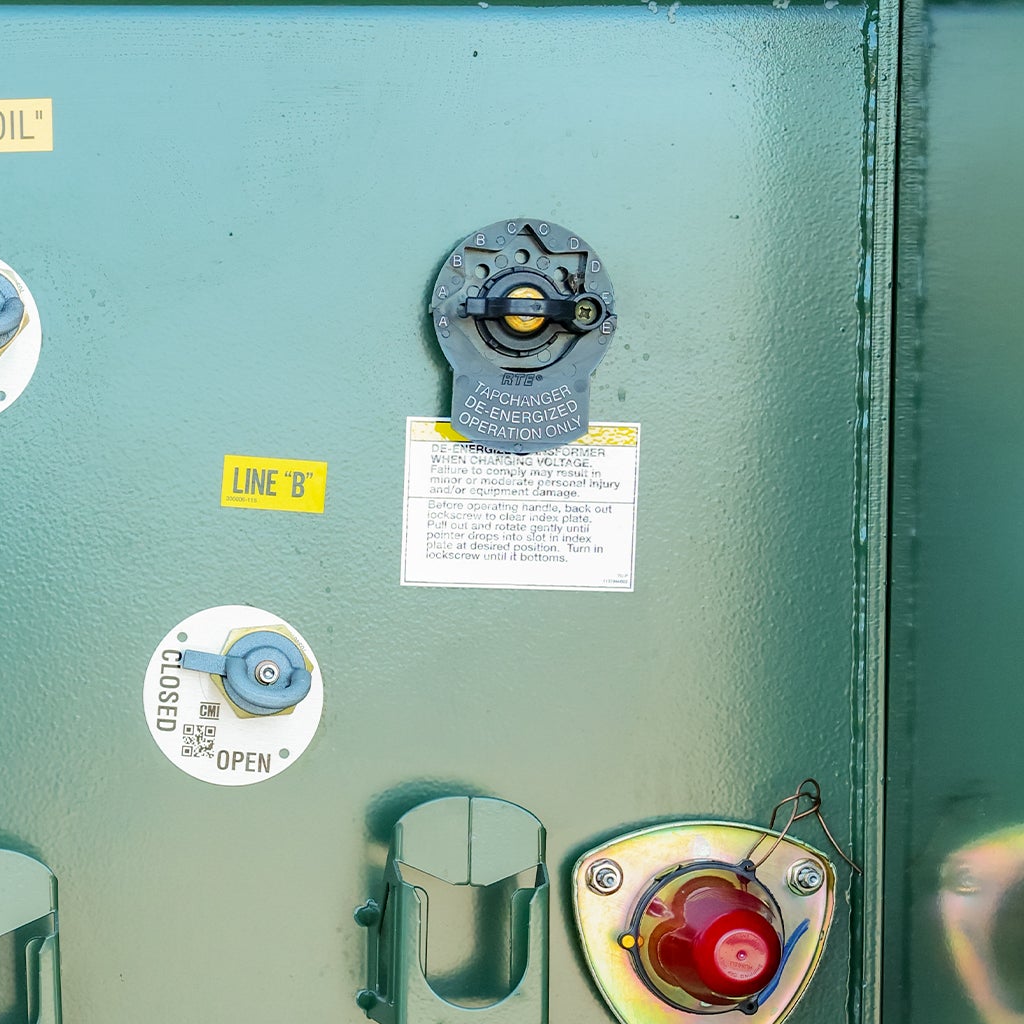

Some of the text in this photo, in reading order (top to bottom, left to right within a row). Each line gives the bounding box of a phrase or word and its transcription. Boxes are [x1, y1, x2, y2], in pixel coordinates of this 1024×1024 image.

[507, 222, 516, 234] C
[539, 223, 548, 235] C
[476, 234, 485, 246] B
[571, 238, 579, 249] D
[453, 255, 462, 267] B
[592, 261, 600, 273] D
[438, 286, 448, 297] A
[602, 292, 610, 304] E
[439, 316, 448, 327] A
[602, 321, 610, 333] E
[474, 381, 572, 407] TAPCHANGER
[464, 395, 578, 424] DE-ENERGIZED
[458, 411, 582, 441] OPERATION ONLY
[431, 455, 593, 468] WHEN CHANGING VOLTAGE.
[431, 464, 601, 479] Failure to comply may result in
[233, 467, 278, 496] LINE
[430, 476, 621, 490] minor or moderate personal injury
[429, 485, 580, 499] and/or equipment damage.
[428, 500, 612, 514] Before operating handle, back out
[427, 511, 593, 524] lockscrew to clear index plate.
[427, 520, 590, 534] Pull out and rotate gently until
[426, 531, 592, 543] pointer drops into slot in index
[426, 541, 604, 554] plate at desired position. Turn in
[426, 551, 569, 563] lockscrew until it bottoms.
[156, 649, 183, 732] CLOSED
[199, 704, 221, 718] CMI
[216, 749, 271, 774] OPEN
